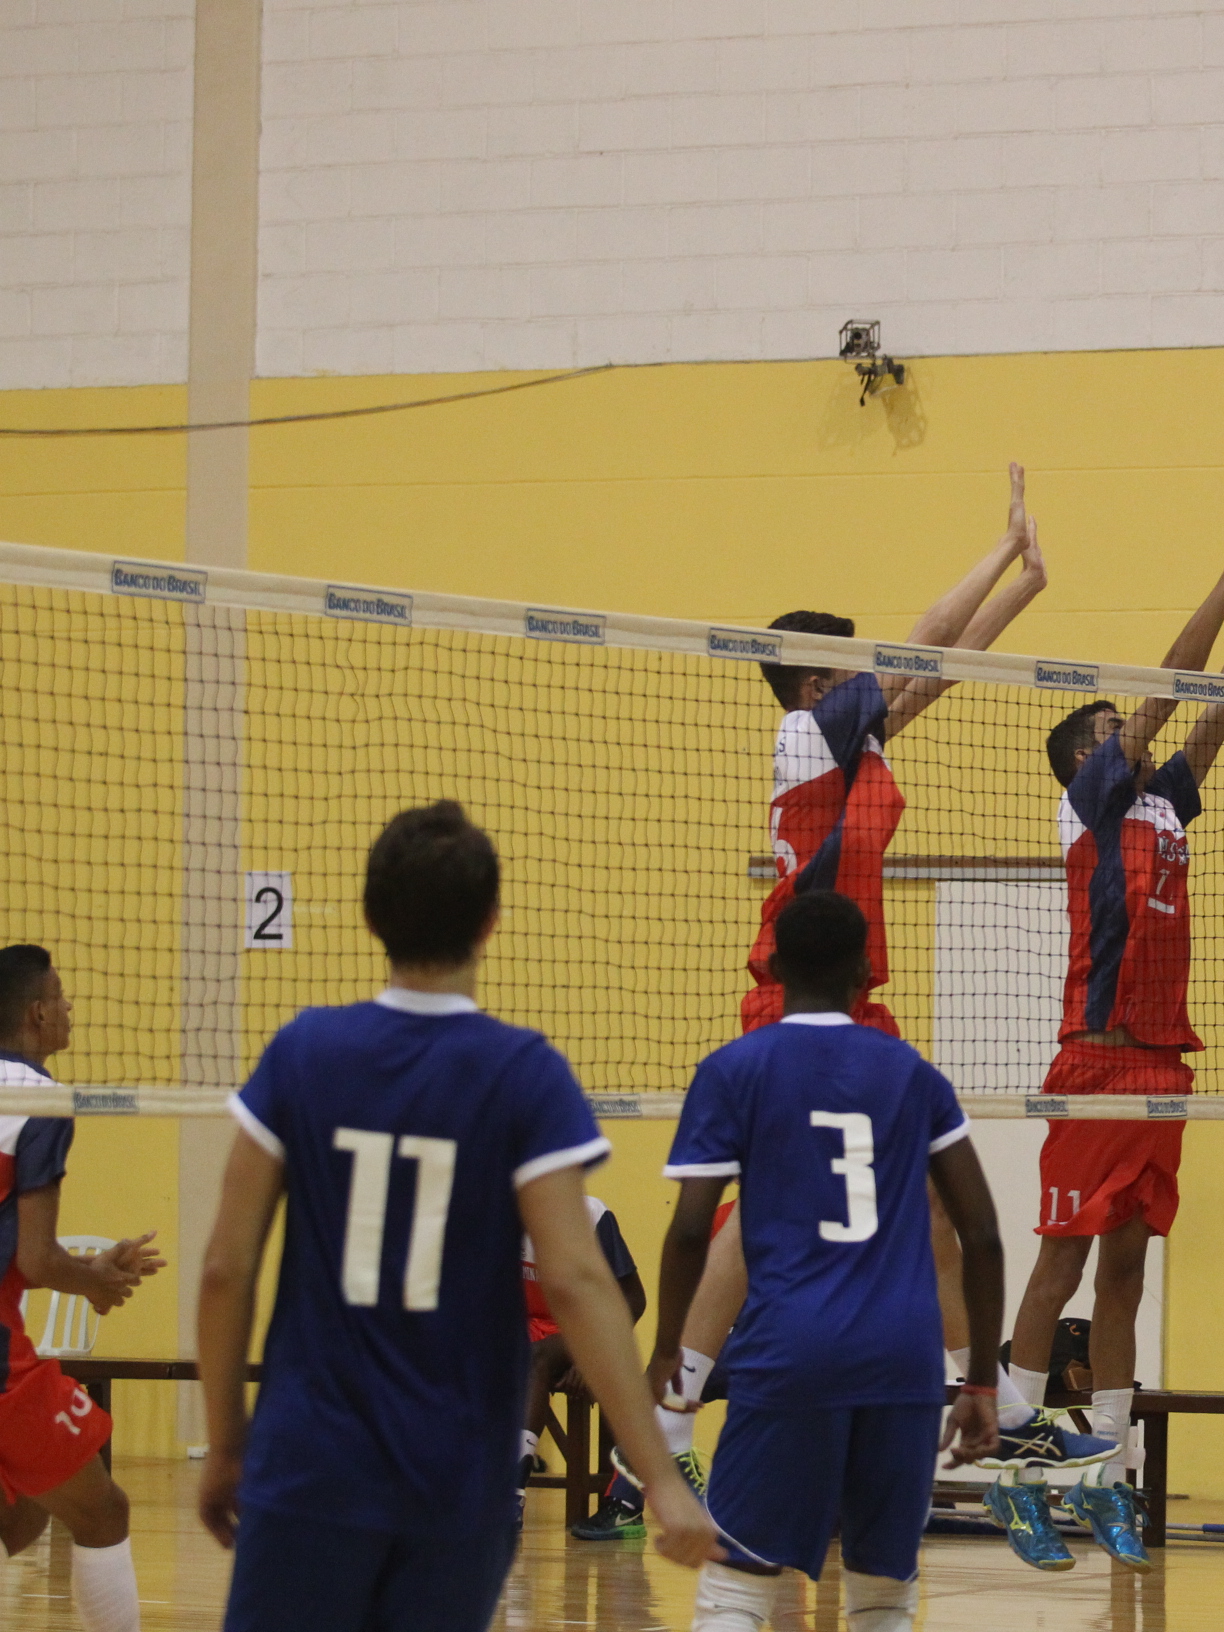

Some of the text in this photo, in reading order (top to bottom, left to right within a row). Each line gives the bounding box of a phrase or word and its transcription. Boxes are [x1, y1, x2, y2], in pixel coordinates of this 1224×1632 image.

[253, 887, 283, 940] 2
[333, 1127, 457, 1311] 11
[810, 1110, 879, 1243] 3
